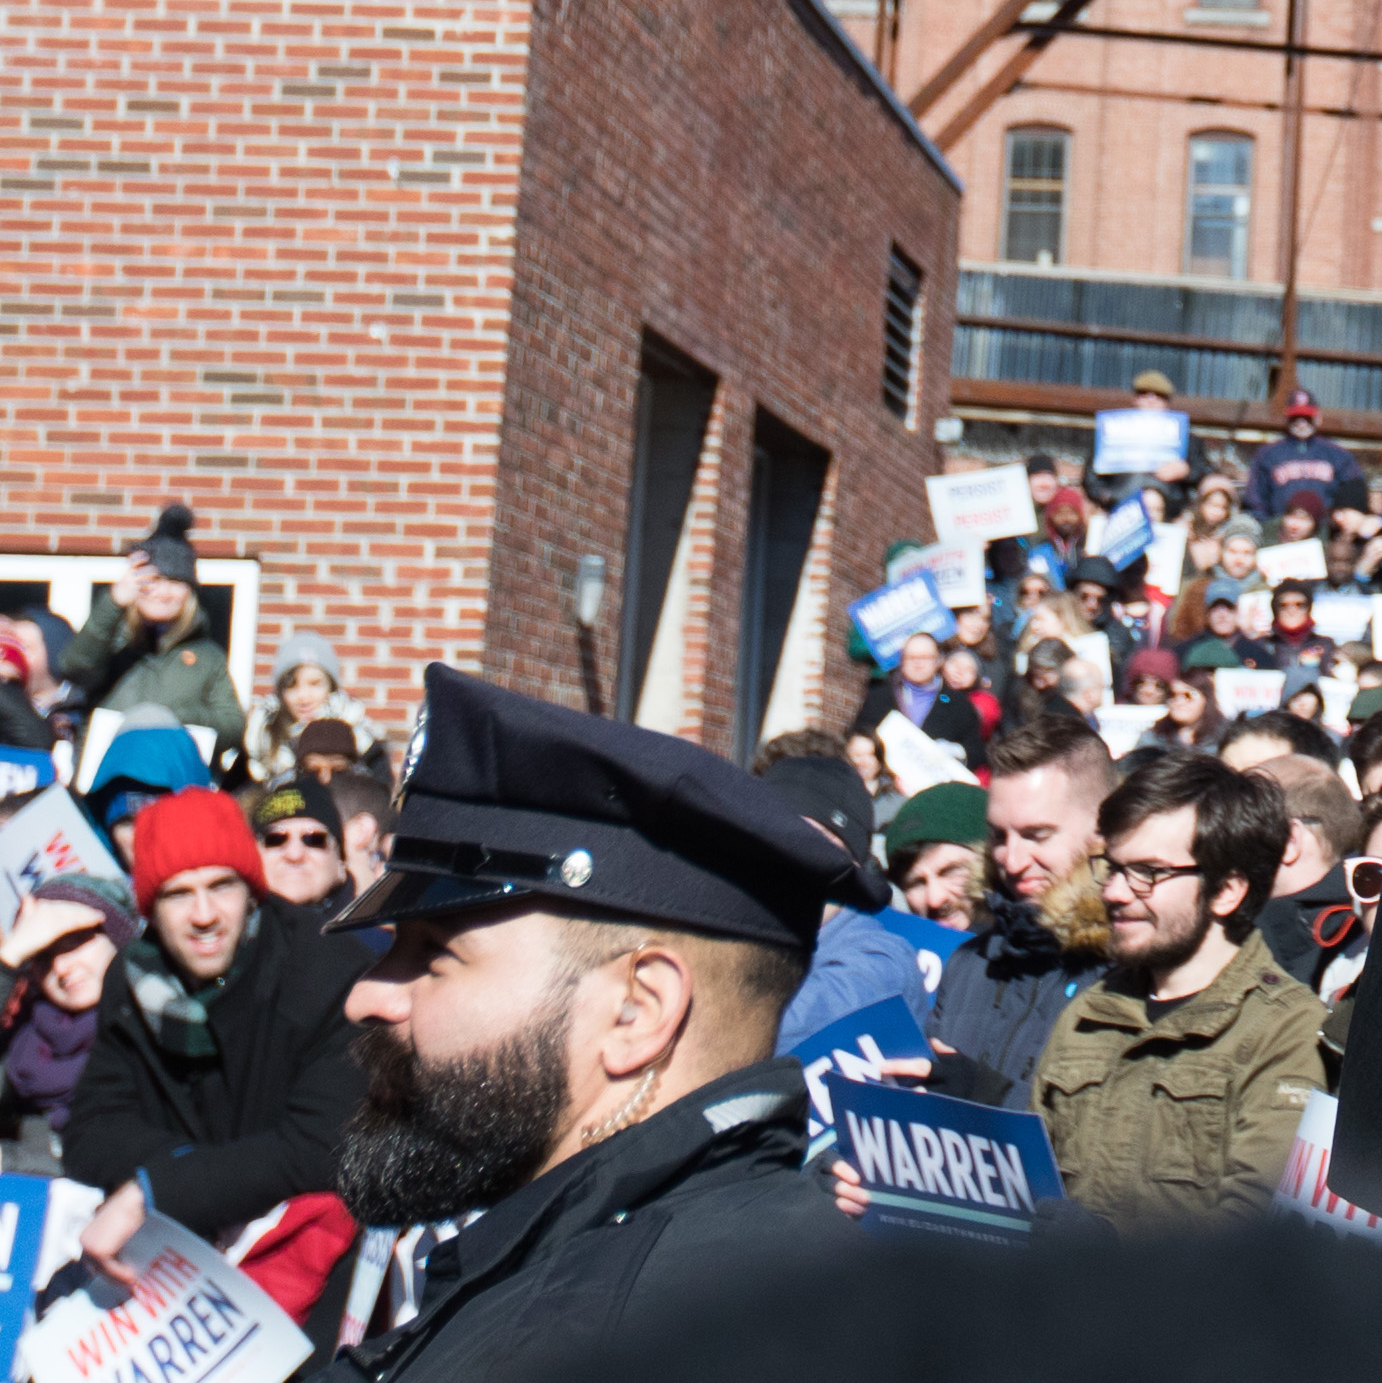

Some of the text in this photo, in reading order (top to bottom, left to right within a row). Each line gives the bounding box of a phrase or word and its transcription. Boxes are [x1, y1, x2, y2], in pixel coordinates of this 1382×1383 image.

[845, 1109, 1036, 1214] WARREN
[68, 1245, 199, 1377] WIN WITH
[114, 1277, 245, 1383] ARREN
